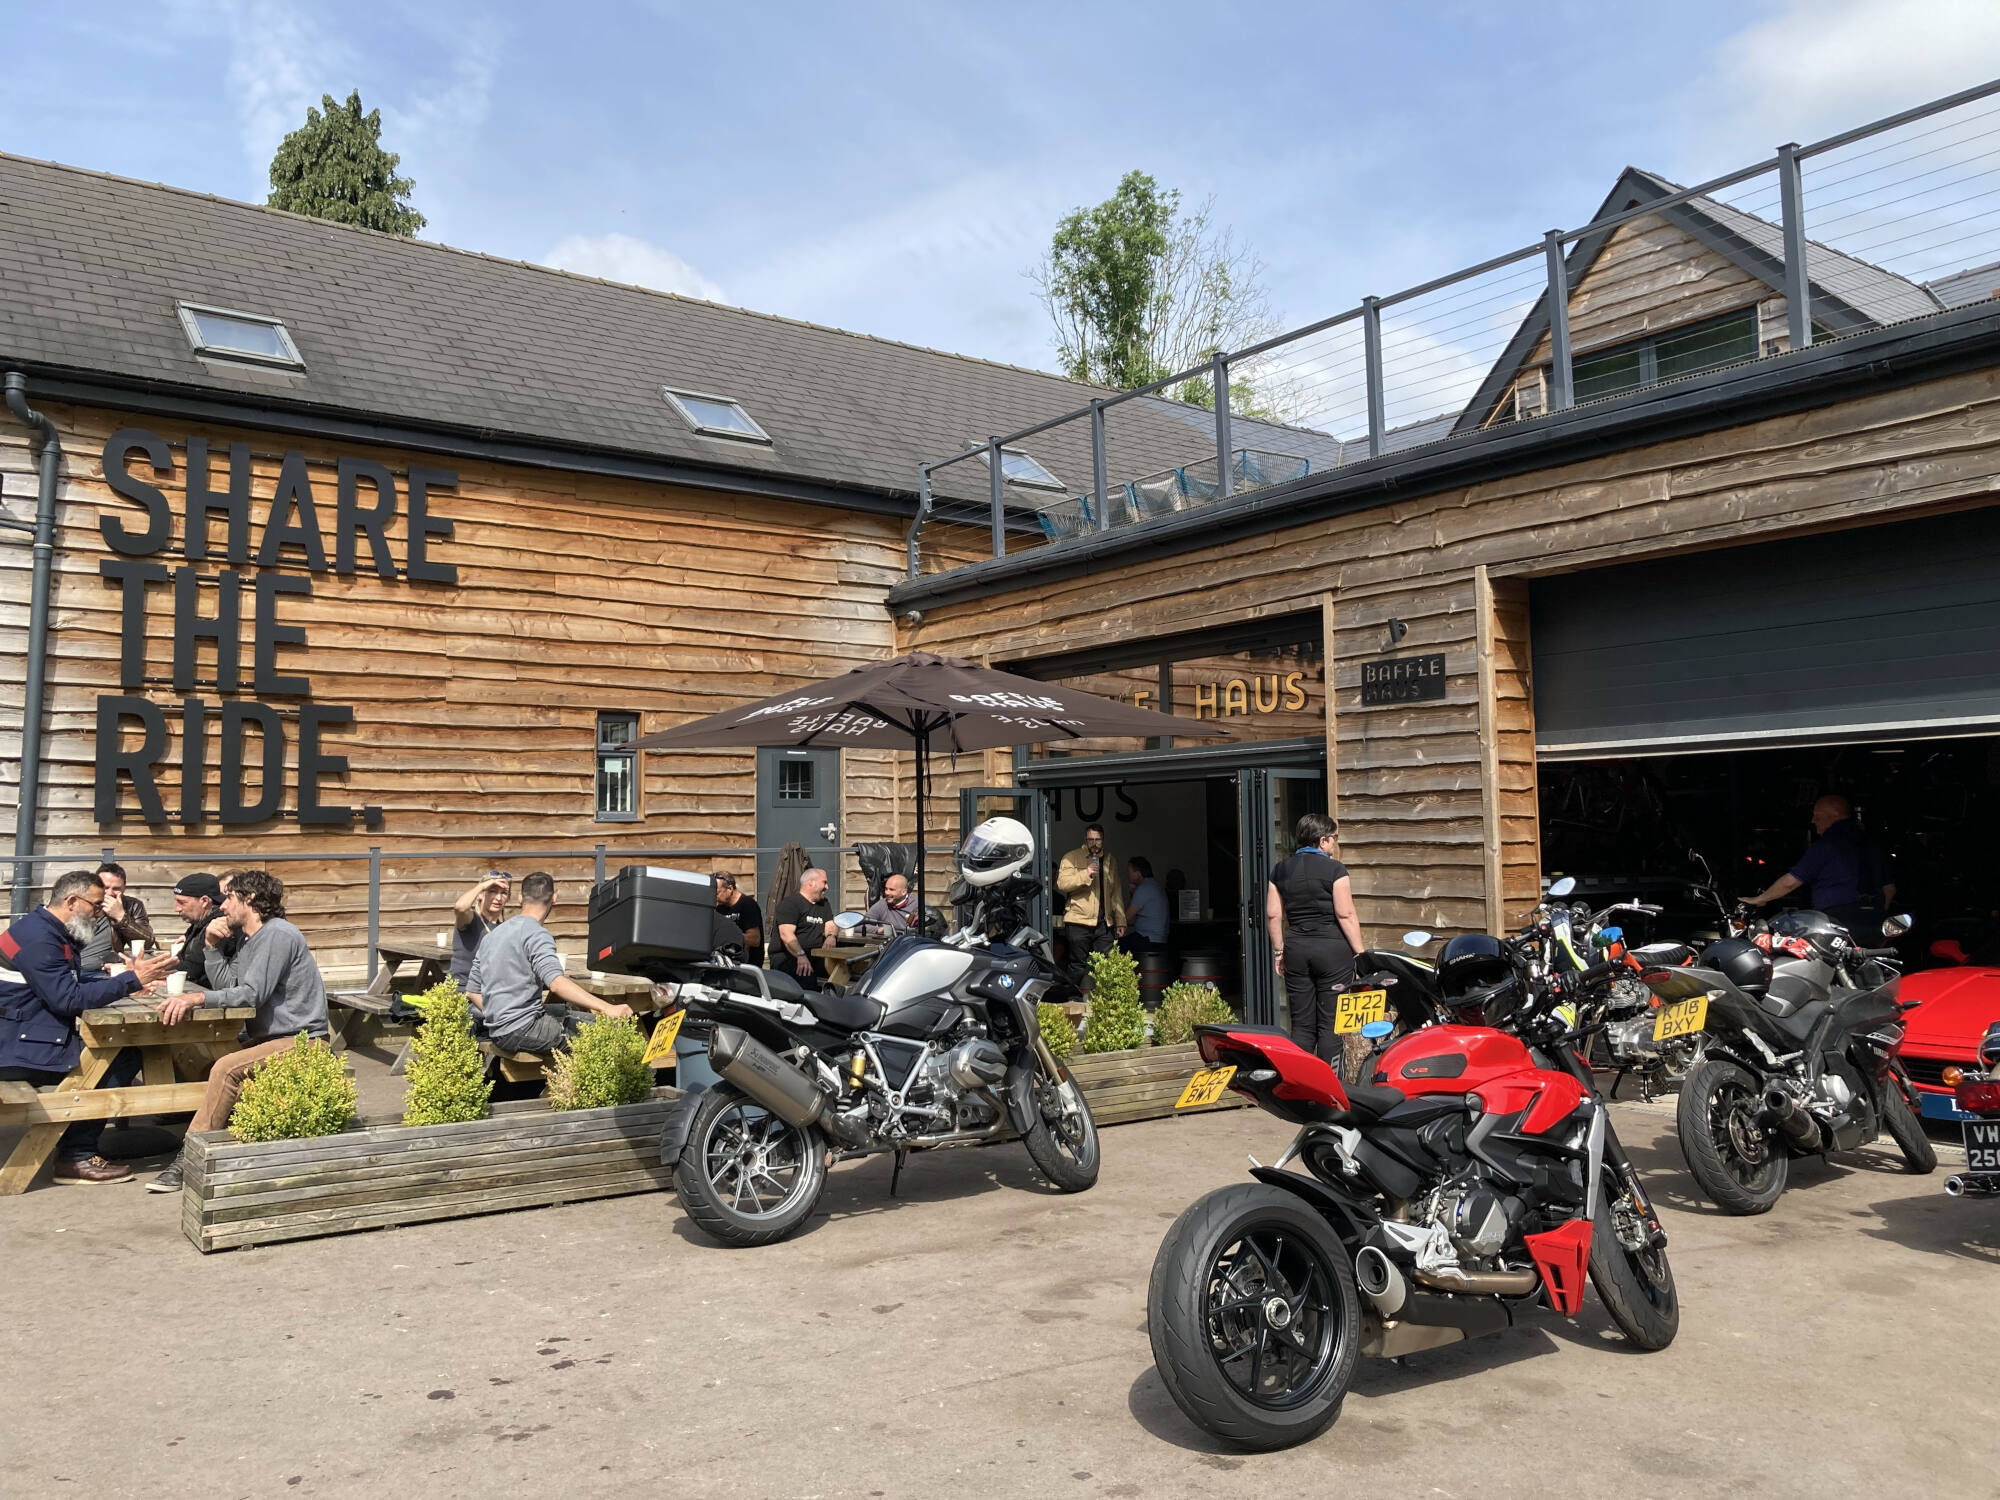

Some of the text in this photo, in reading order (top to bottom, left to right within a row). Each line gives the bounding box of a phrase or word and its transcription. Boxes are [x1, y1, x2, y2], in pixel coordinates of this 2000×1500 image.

[99, 428, 458, 583] SHARE
[99, 559, 313, 695] THE
[1195, 671, 1305, 719] HAUS
[94, 695, 383, 825] RIDE.
[1340, 994, 1383, 1012] BT22
[1662, 1015, 1696, 1037] BXY
